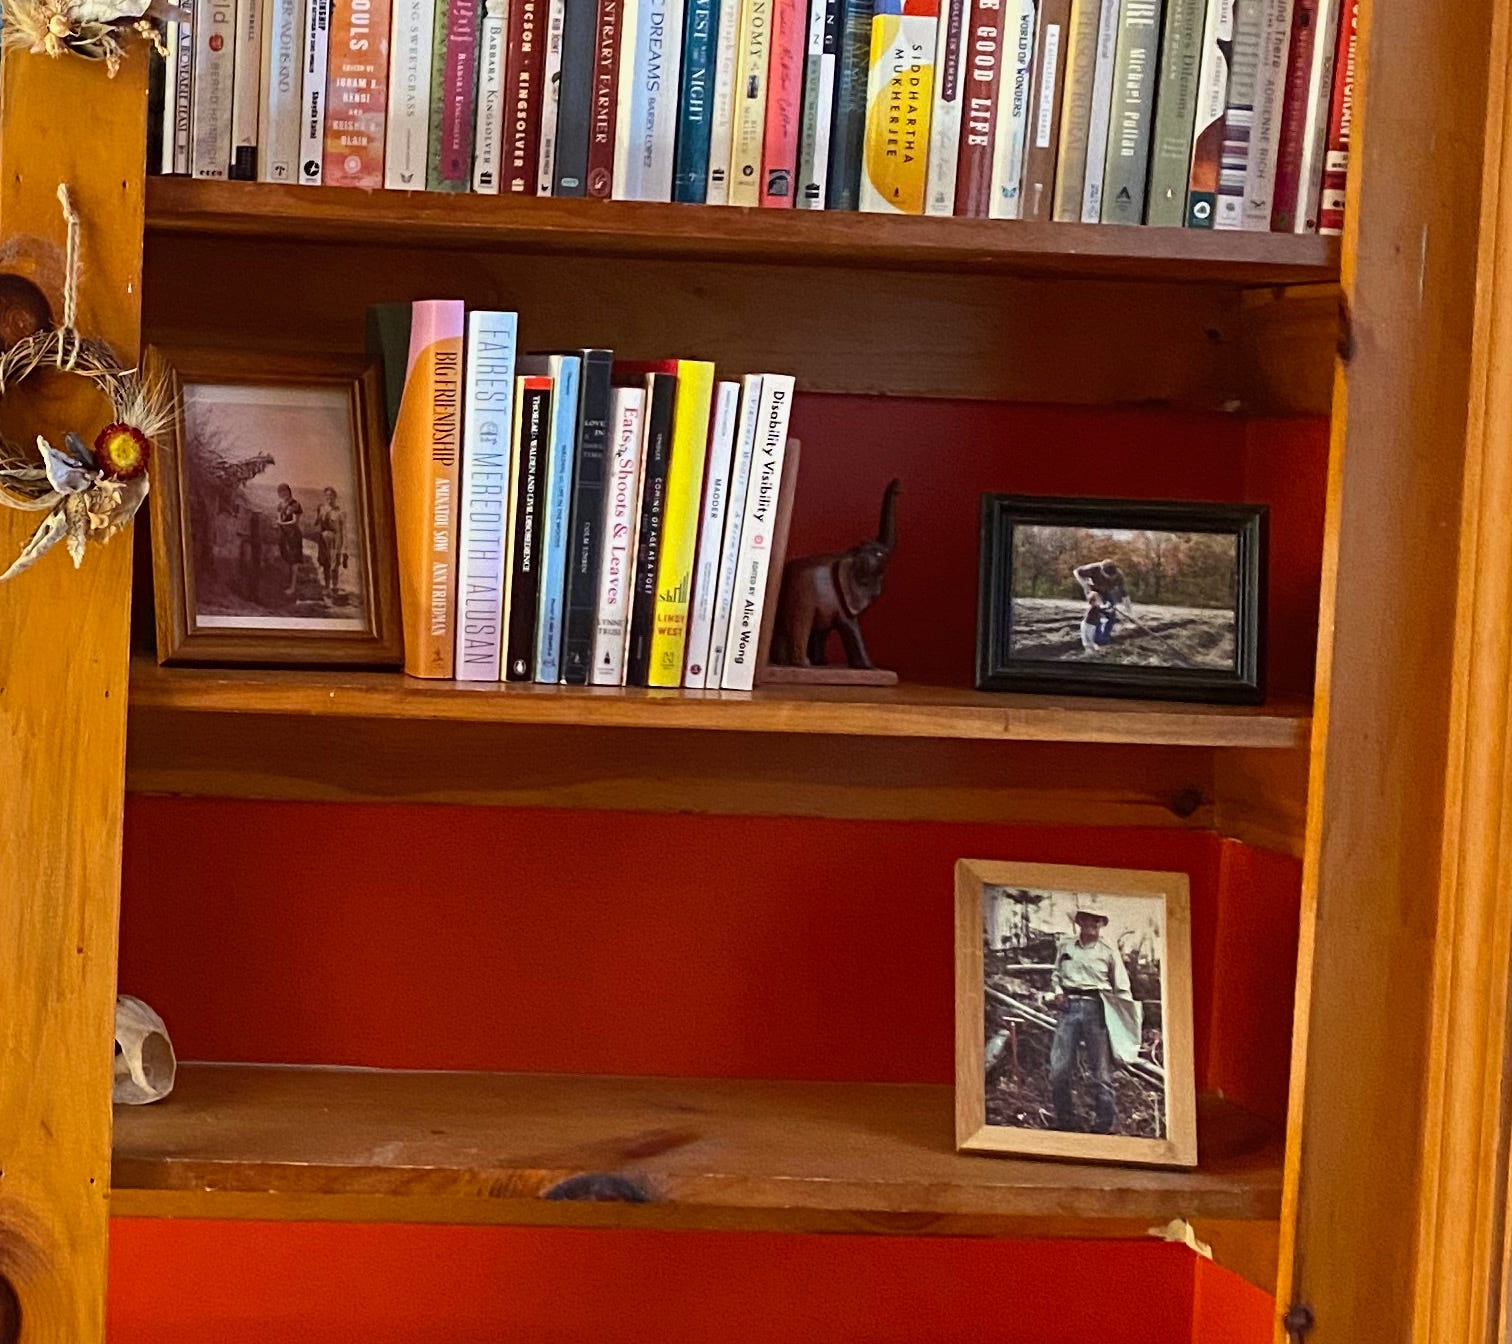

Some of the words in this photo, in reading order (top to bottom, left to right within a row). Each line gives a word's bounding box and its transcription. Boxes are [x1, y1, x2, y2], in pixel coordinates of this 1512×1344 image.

[647, 12, 665, 92] DREAMS
[973, 26, 996, 82] GOOD
[969, 98, 991, 146] LIFE
[434, 351, 457, 377] BIG
[432, 379, 456, 467] FRIENDSHIP
[621, 406, 639, 444] Eats,
[762, 391, 785, 457] Disability
[613, 458, 632, 518] Shoots
[753, 461, 775, 523] Visibility
[613, 523, 627, 538] &
[607, 545, 626, 605] Leaves
[741, 599, 754, 627] Alice
[734, 630, 752, 664] Wong
